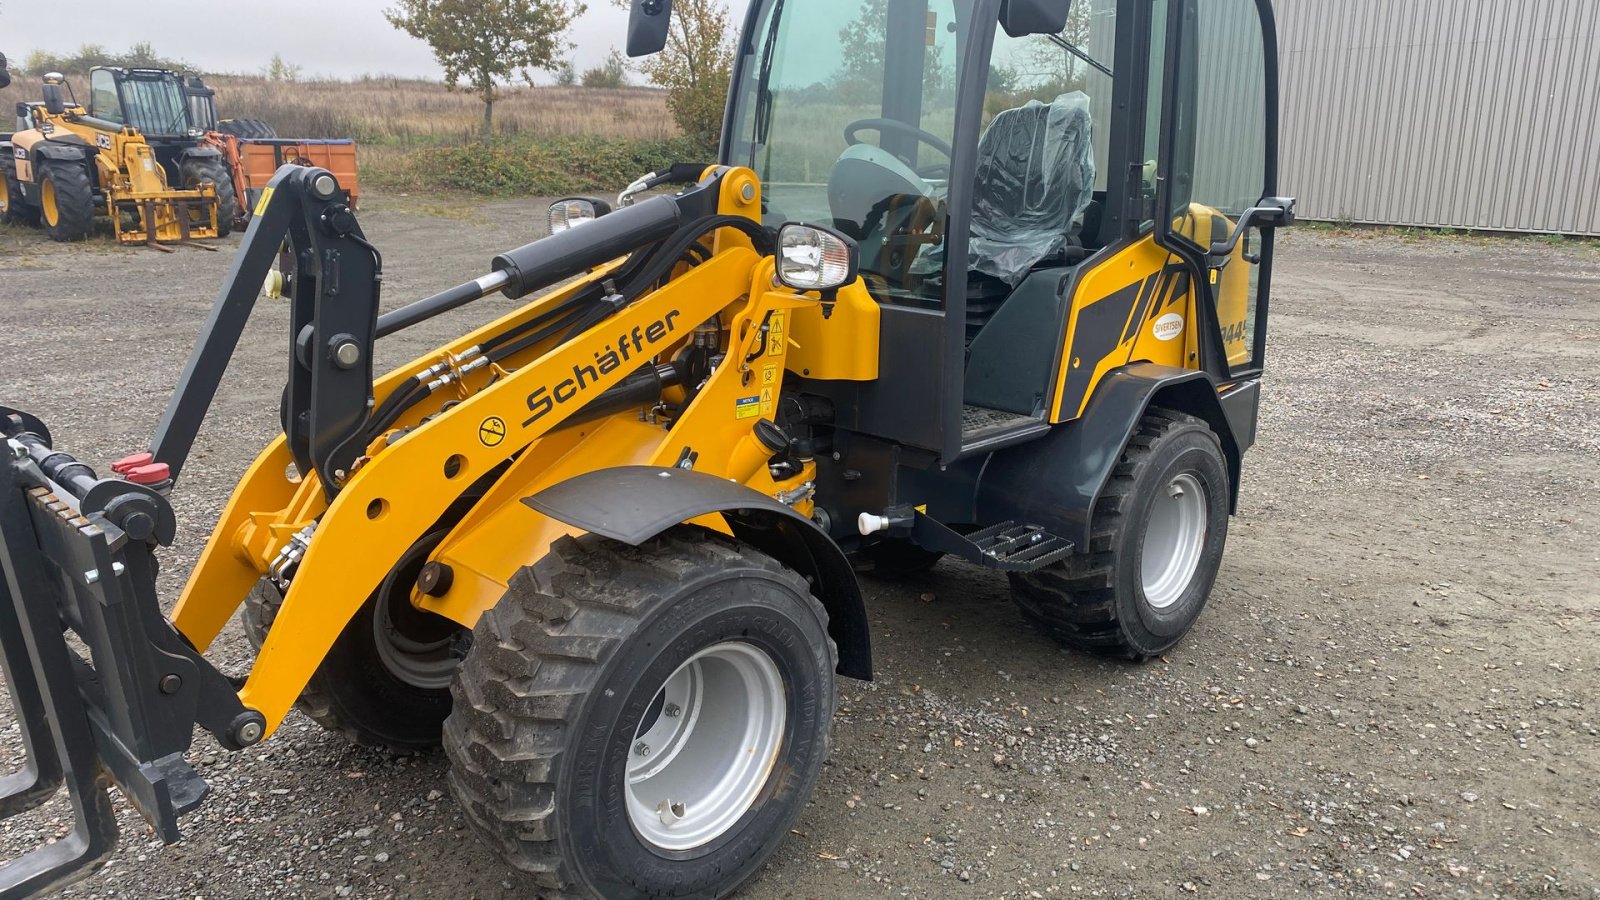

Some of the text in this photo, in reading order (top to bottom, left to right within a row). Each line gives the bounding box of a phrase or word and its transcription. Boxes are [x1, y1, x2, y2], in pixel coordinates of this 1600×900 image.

[97, 134, 111, 149] JCB
[1155, 319, 1182, 333] SIVERTSEN
[521, 309, 681, 429] Schäffer
